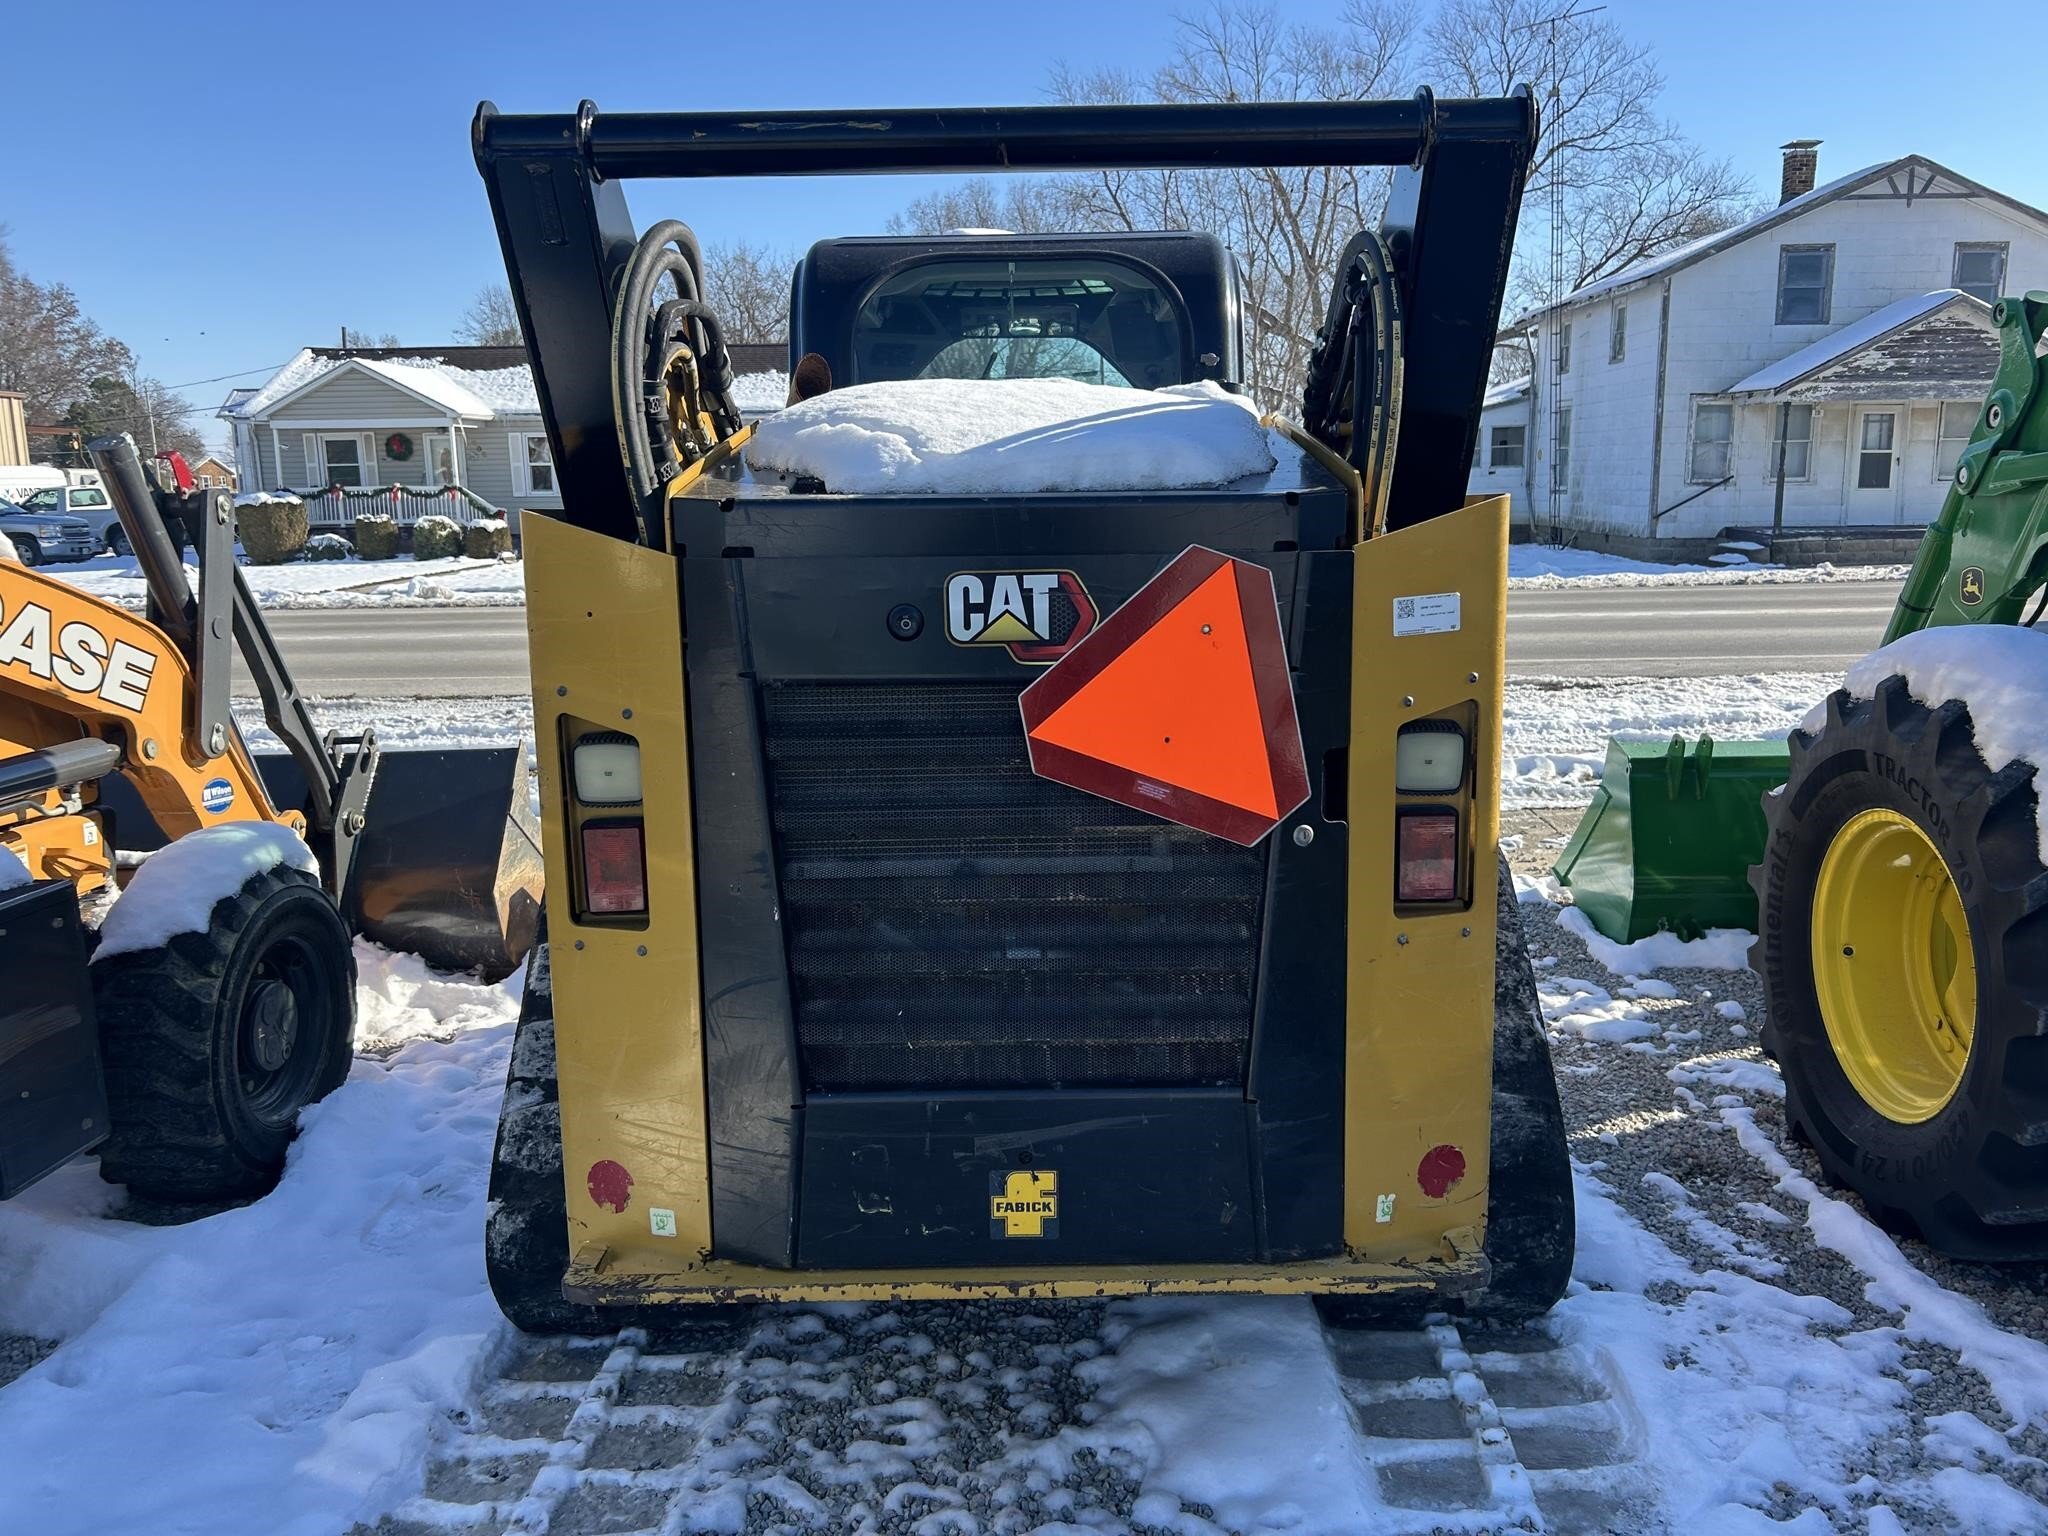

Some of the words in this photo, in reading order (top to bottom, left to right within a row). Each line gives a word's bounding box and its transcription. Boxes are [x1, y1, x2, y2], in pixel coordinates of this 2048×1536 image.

[0, 592, 159, 714] ASE
[949, 574, 1059, 642] CAT
[1873, 751, 1950, 848] TRACTOR
[1952, 851, 1974, 894] 70
[996, 1201, 1053, 1213] FABICK
